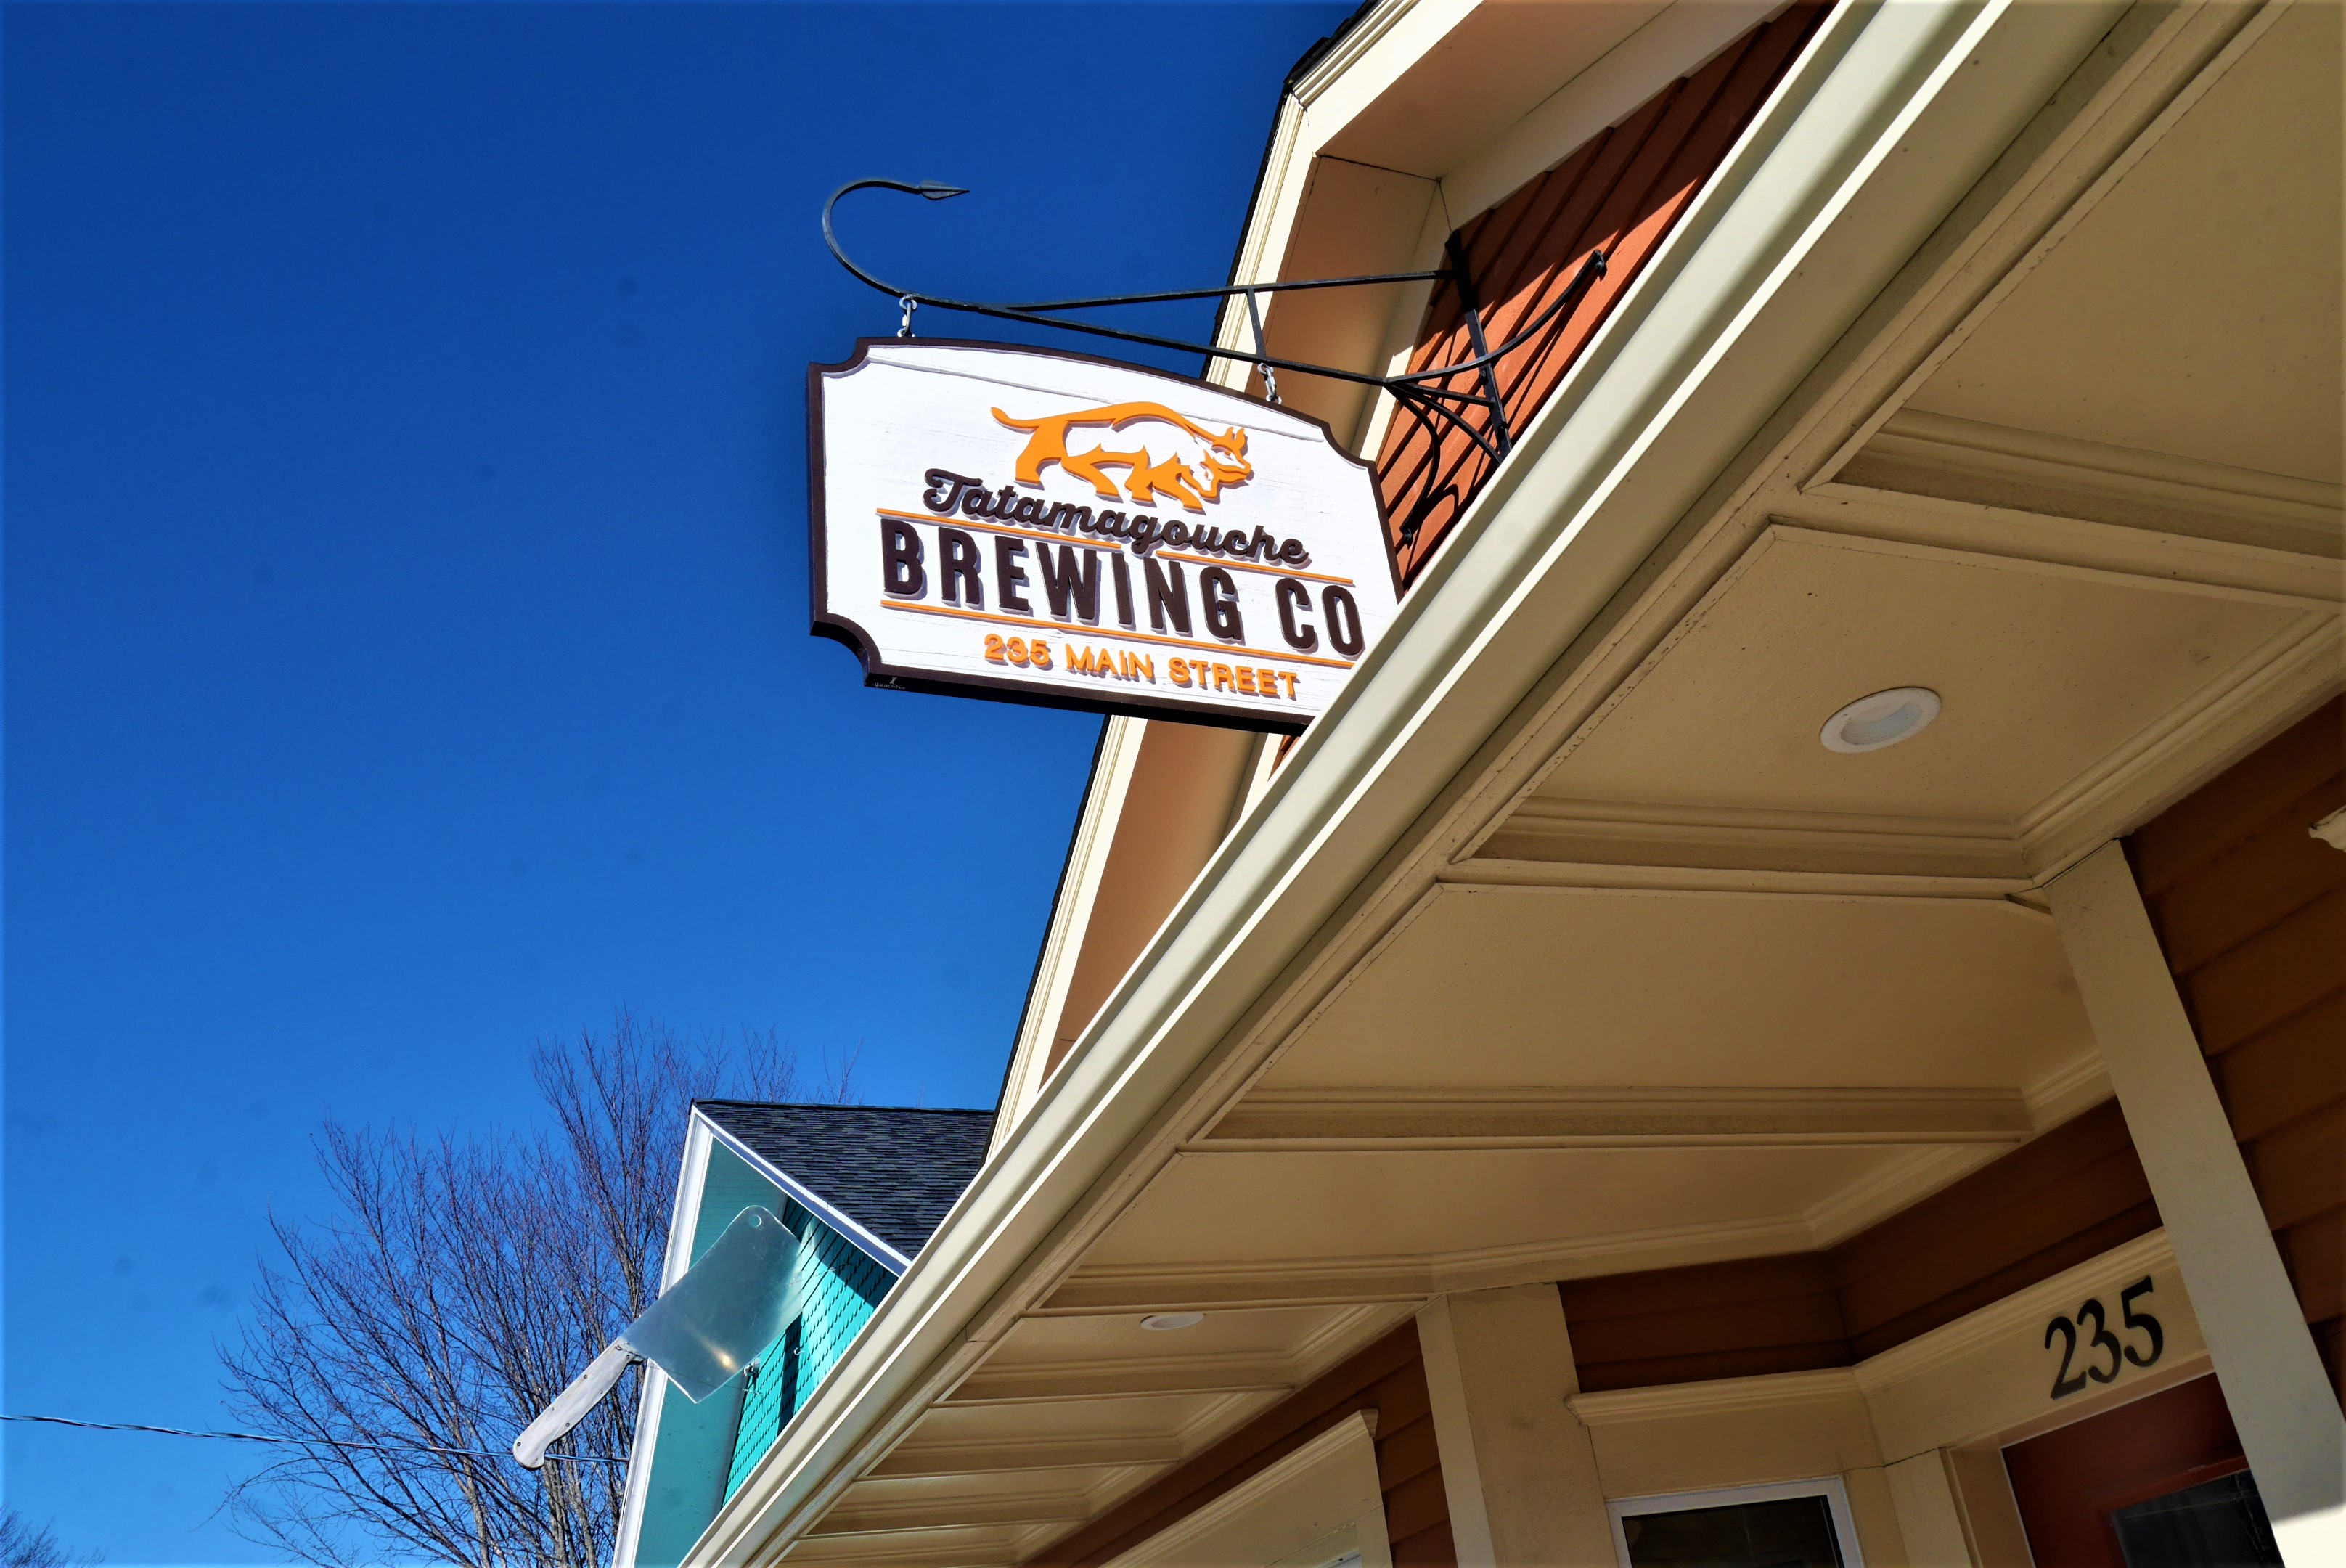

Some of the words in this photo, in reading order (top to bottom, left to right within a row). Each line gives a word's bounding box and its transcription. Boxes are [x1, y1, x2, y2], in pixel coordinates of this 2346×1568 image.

[923, 468, 1309, 565] Tatamagouche
[880, 518, 1242, 640] BREWING
[1275, 577, 1364, 656] CO
[984, 633, 1050, 666] 235
[1065, 643, 1154, 679] MAIN
[1168, 657, 1298, 698] STREET
[2044, 1275, 2164, 1400] 235
